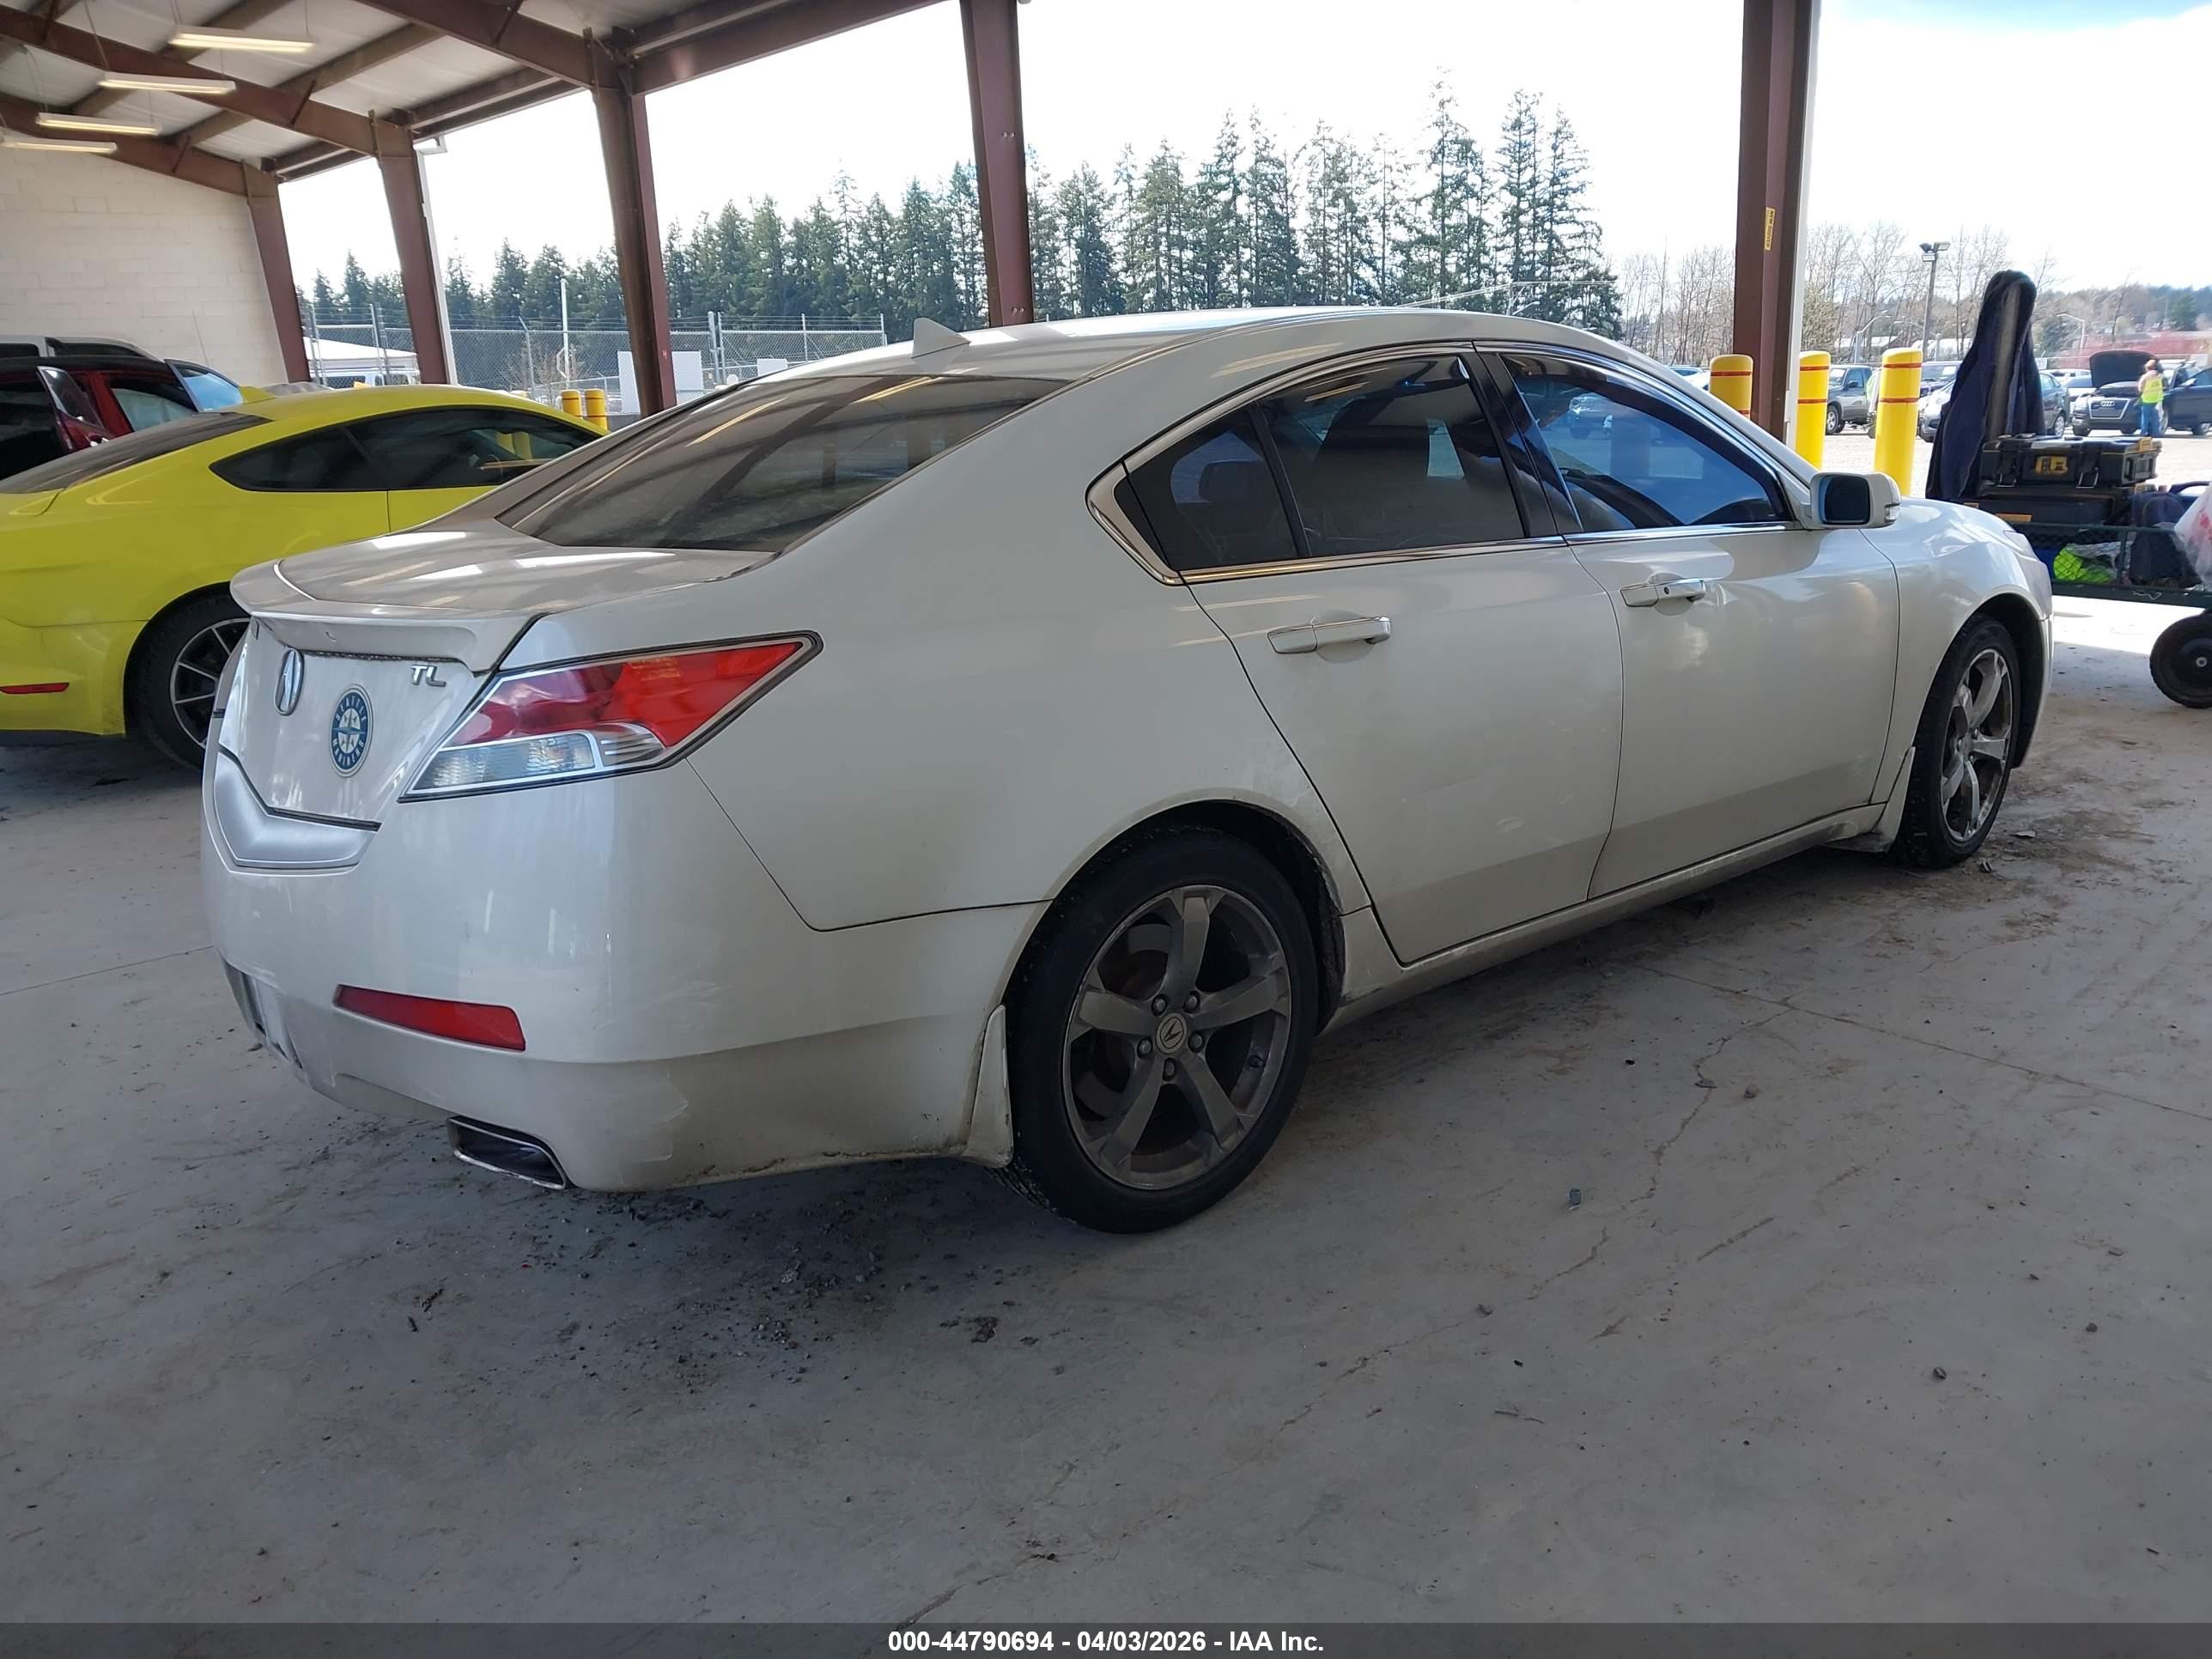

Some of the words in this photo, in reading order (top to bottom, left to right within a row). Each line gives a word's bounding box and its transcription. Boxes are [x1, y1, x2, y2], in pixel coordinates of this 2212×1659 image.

[410, 665, 447, 687] TL
[335, 696, 367, 722] SEATTLE
[332, 738, 365, 766] MARINERS
